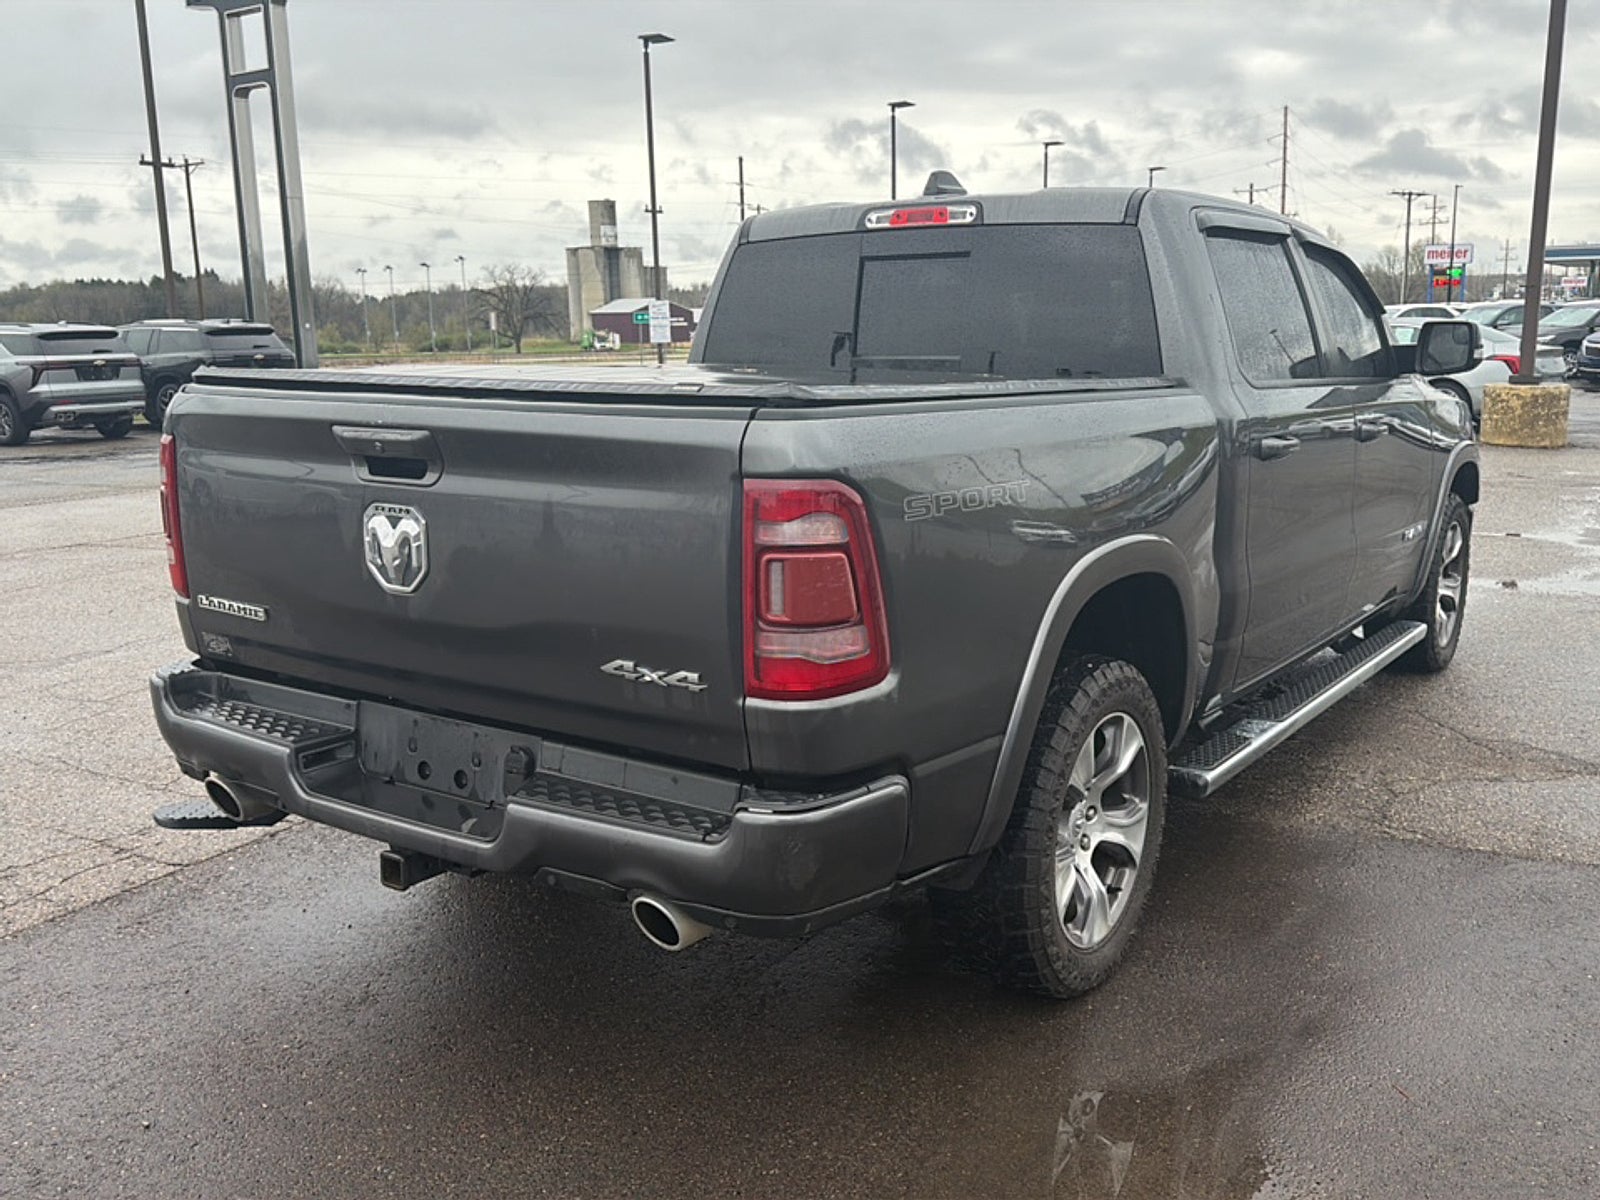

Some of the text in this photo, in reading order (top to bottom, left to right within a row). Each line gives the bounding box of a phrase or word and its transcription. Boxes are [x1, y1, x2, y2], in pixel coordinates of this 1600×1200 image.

[1427, 248, 1469, 260] meier
[374, 504, 411, 515] RAM
[903, 479, 1031, 521] SPORT
[197, 594, 266, 621] LARAMIE
